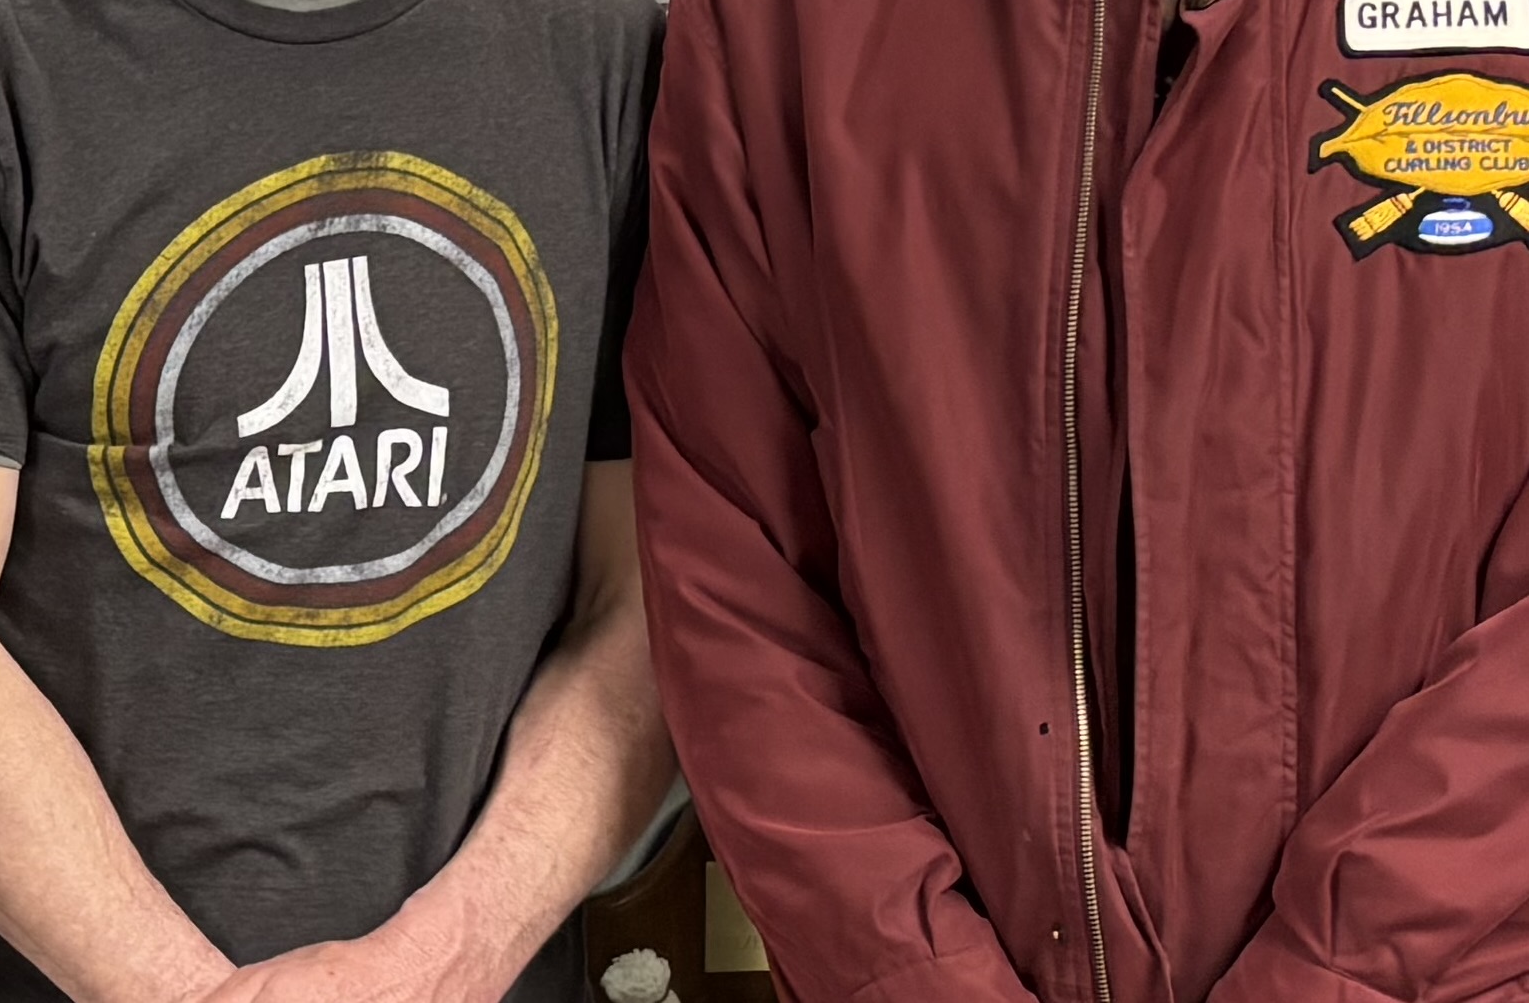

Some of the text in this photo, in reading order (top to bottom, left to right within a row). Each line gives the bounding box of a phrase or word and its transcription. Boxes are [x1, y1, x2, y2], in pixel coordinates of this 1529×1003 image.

[1357, 0, 1509, 29] GRAHAM
[1405, 139, 1512, 155] & DISTRICT
[1383, 155, 1529, 174] CURLING CLUB
[221, 426, 448, 519] ATARI
